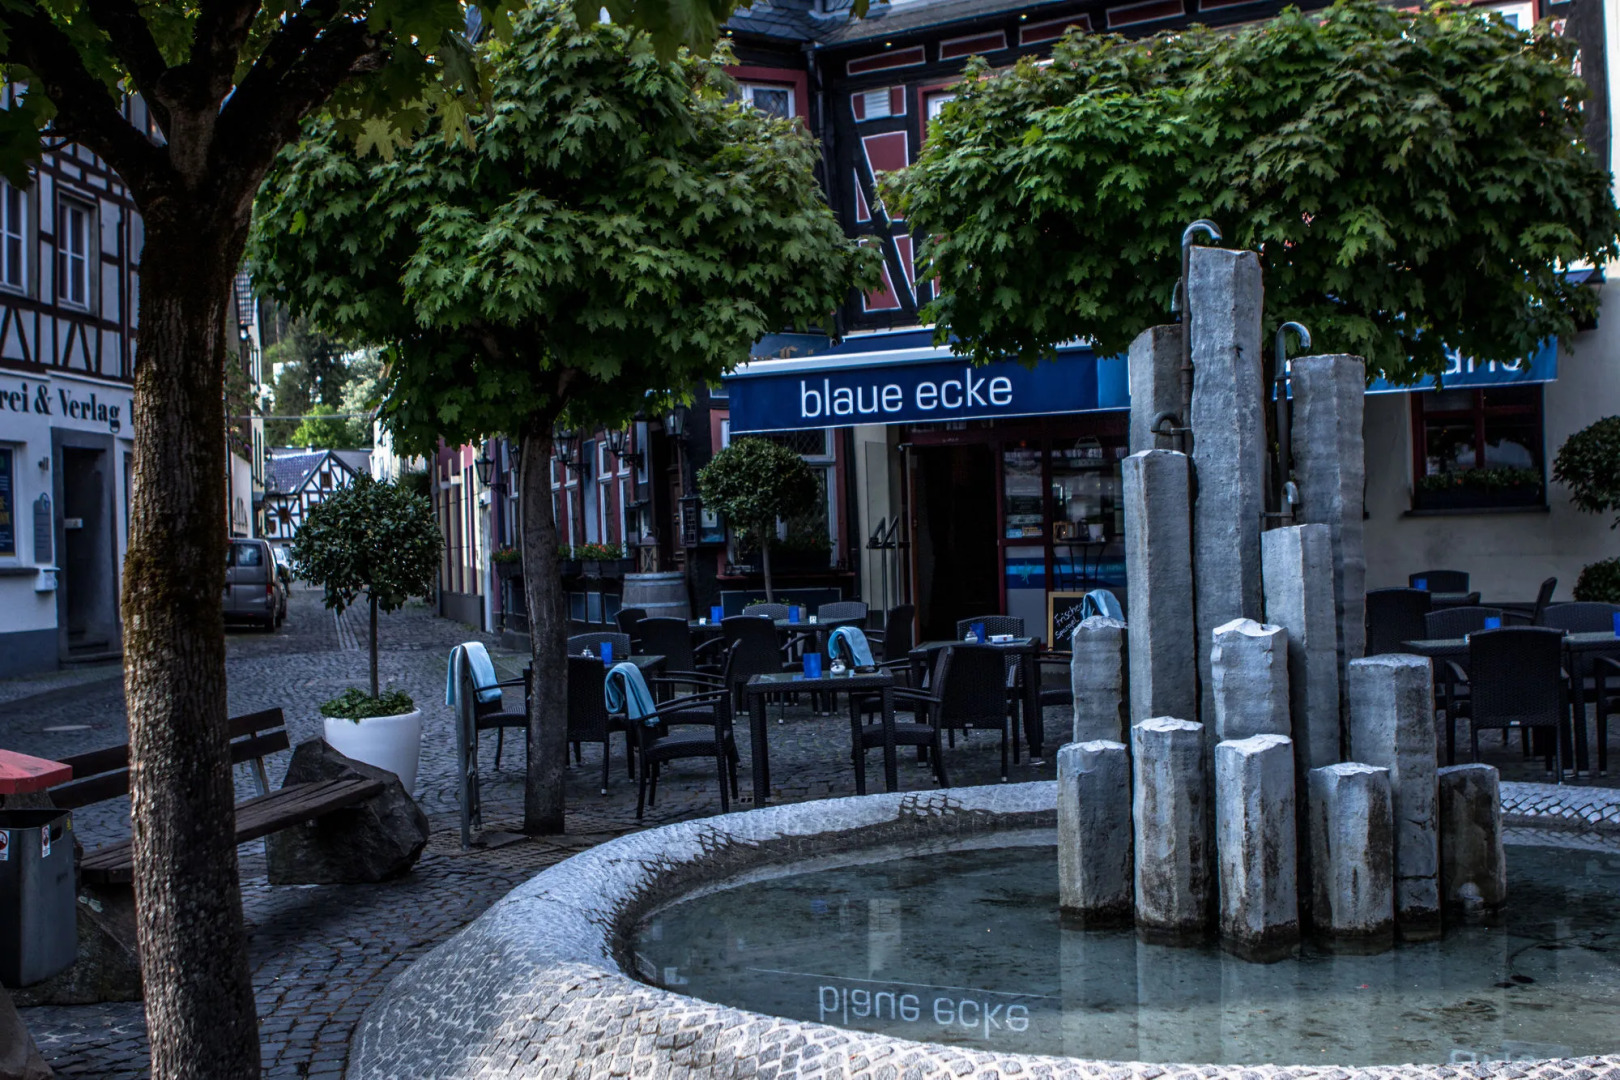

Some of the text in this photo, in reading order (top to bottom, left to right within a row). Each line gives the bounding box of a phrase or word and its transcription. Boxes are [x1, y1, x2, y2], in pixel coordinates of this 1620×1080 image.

[34, 384, 53, 415] &
[57, 388, 120, 433] Verlag
[801, 367, 1013, 418] blaue ecke
